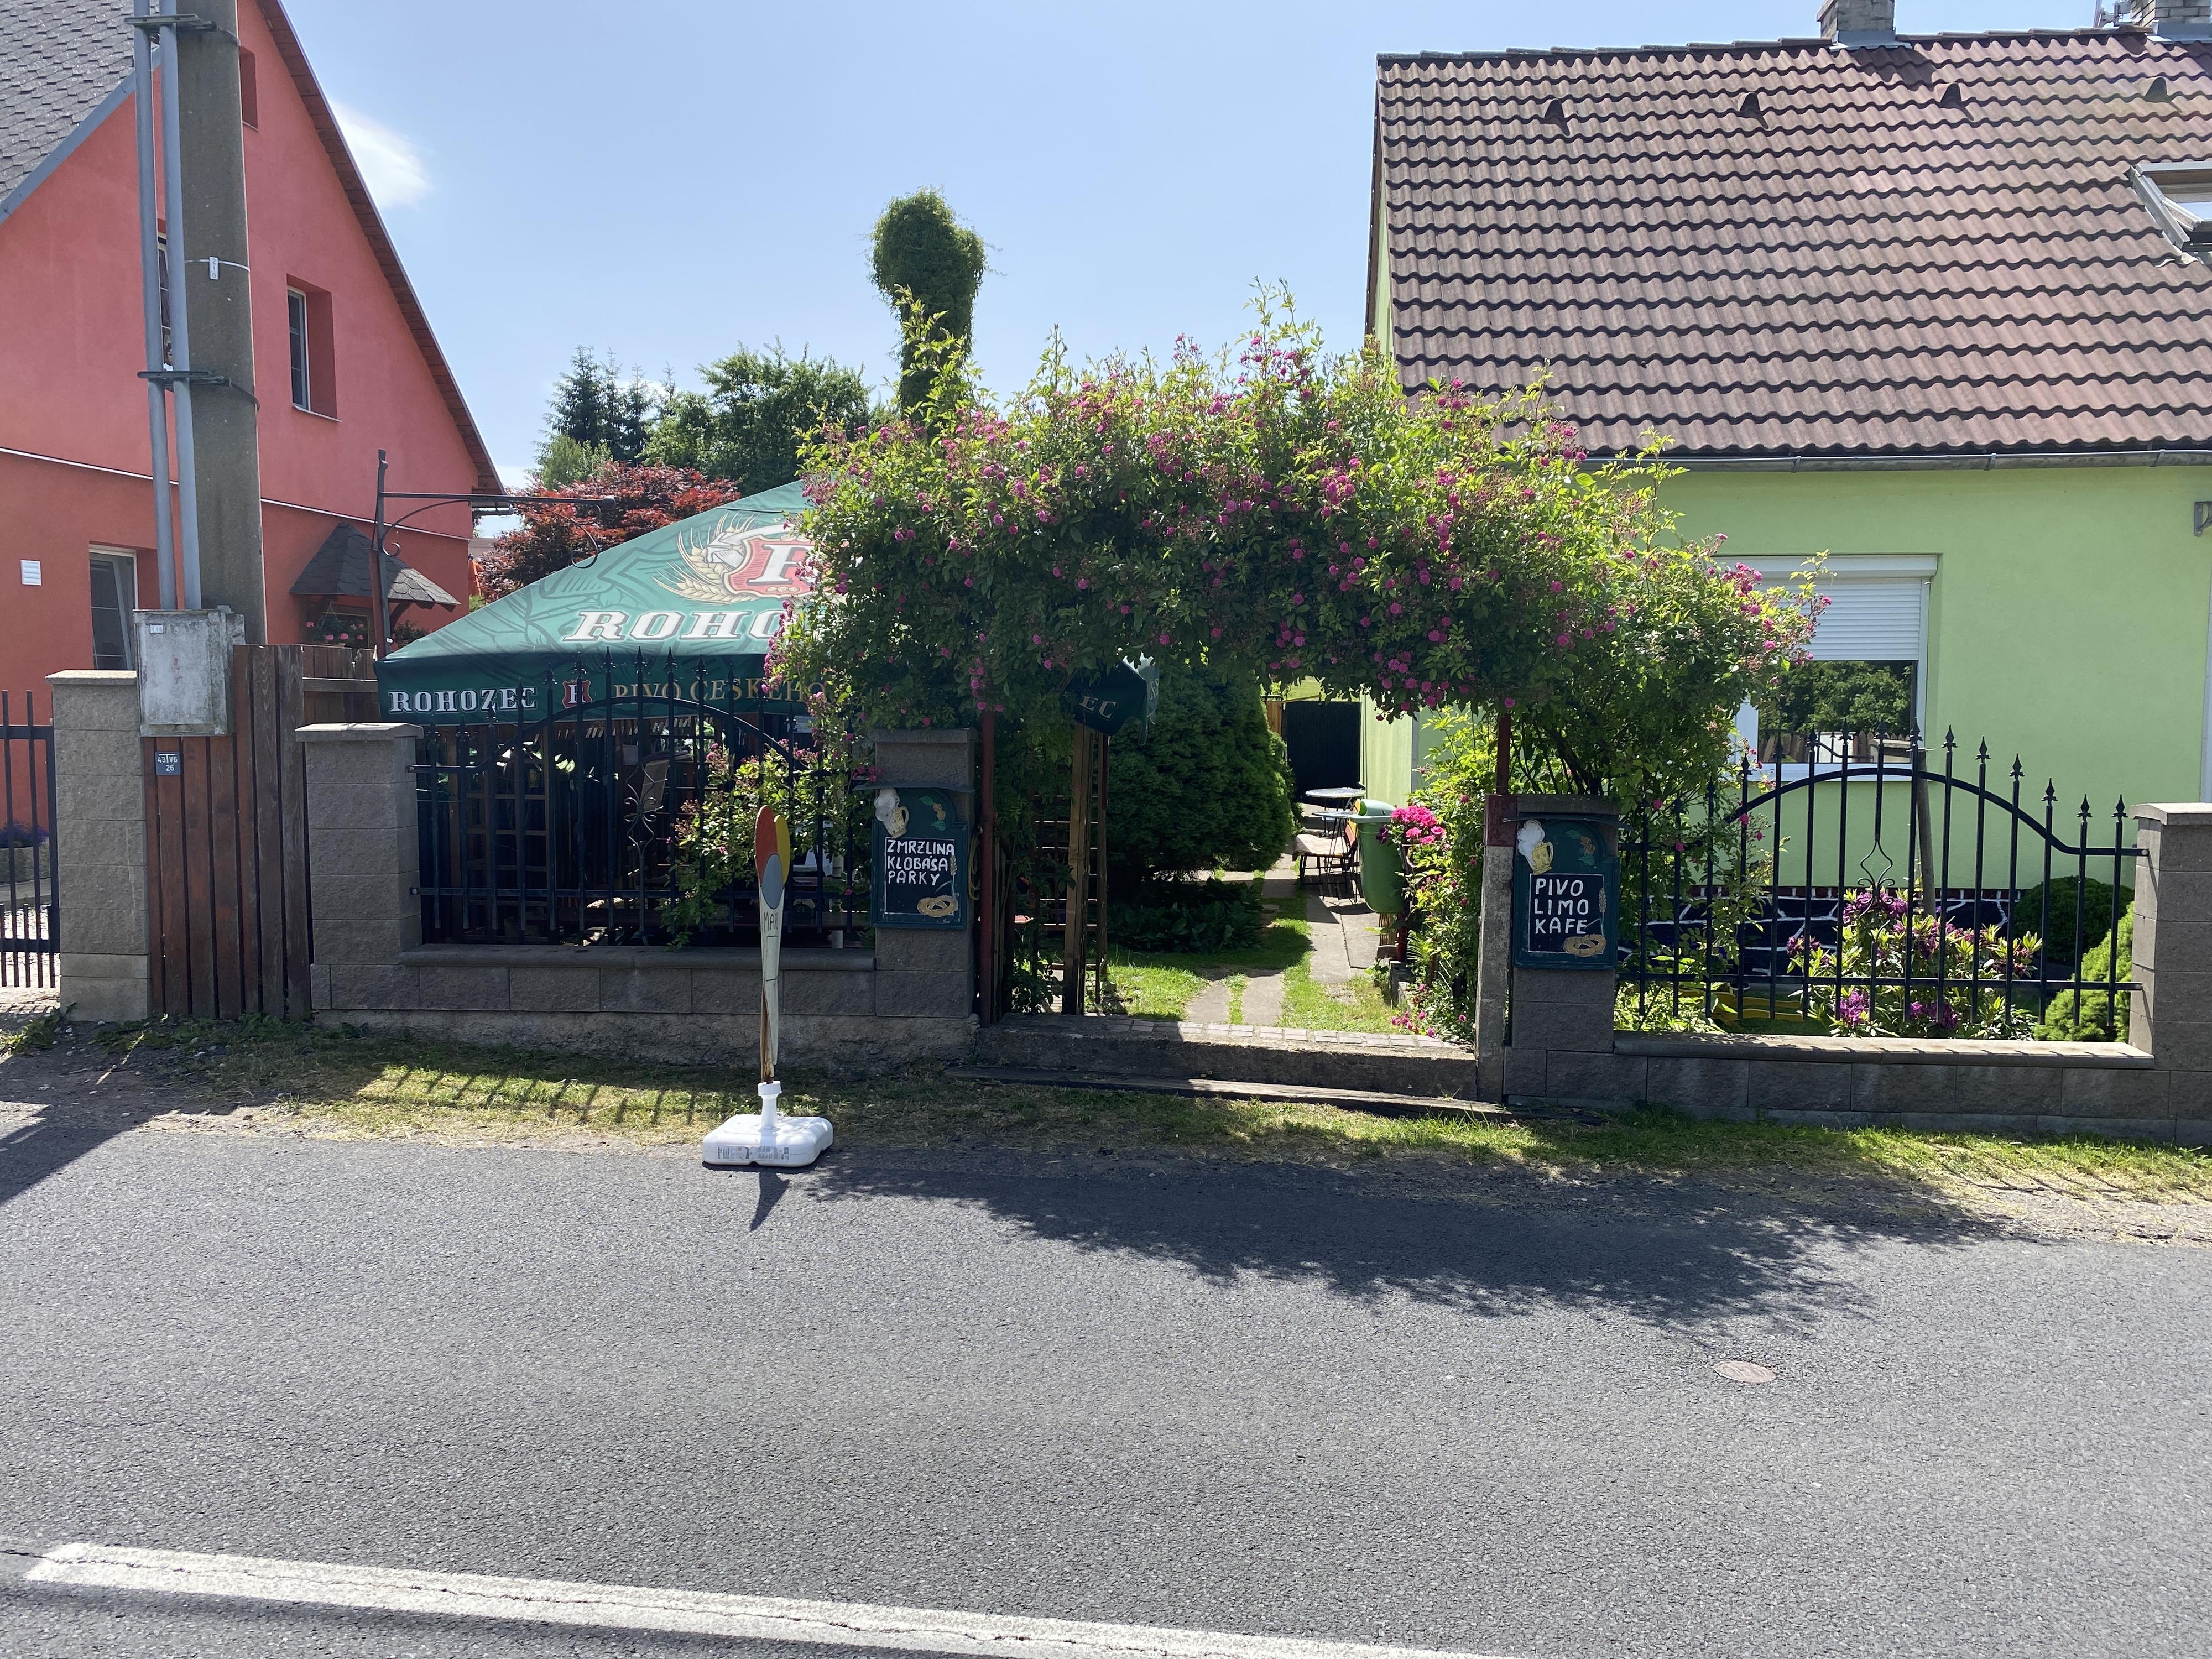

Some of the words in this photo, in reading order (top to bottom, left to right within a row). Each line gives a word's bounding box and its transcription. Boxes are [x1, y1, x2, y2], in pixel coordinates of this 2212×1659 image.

[562, 611, 788, 641] ROHO
[389, 687, 536, 713] ROHOZEC
[614, 681, 682, 700] PIVO
[887, 839, 955, 855] ZMRZLINA
[887, 855, 948, 872] KLOBÁSA
[888, 870, 940, 885] PARKY
[1535, 878, 1584, 896] PIVO
[1534, 898, 1589, 916] LIMO
[1535, 917, 1588, 935] KAFE
